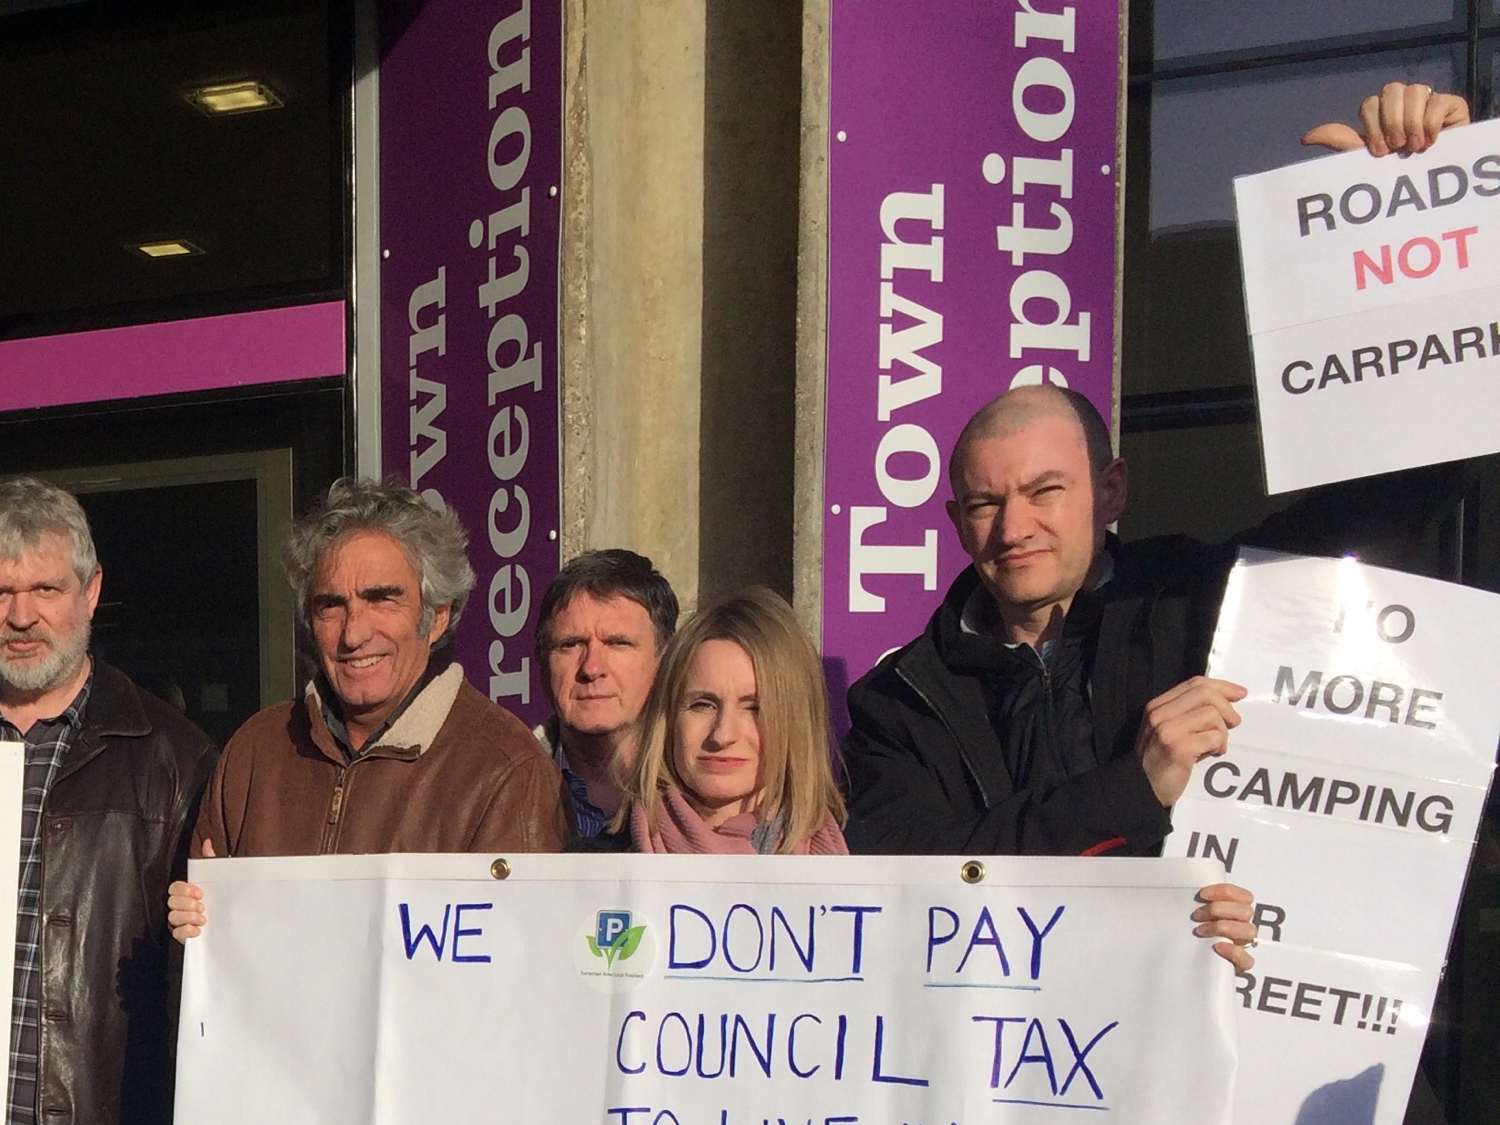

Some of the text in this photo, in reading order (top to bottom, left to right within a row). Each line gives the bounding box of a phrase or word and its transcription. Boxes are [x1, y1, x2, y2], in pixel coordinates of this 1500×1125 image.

[1296, 154, 1500, 237] ROADS
[1353, 226, 1478, 291] NOT
[408, 266, 447, 516] wn
[469, 0, 542, 705] reception
[849, 183, 944, 613] Town
[1271, 665, 1443, 730] MORE
[1203, 761, 1454, 834] CAMPING
[400, 904, 1064, 979] WE DON'T PAY
[617, 1012, 1118, 1100] COUNCIL TAX
